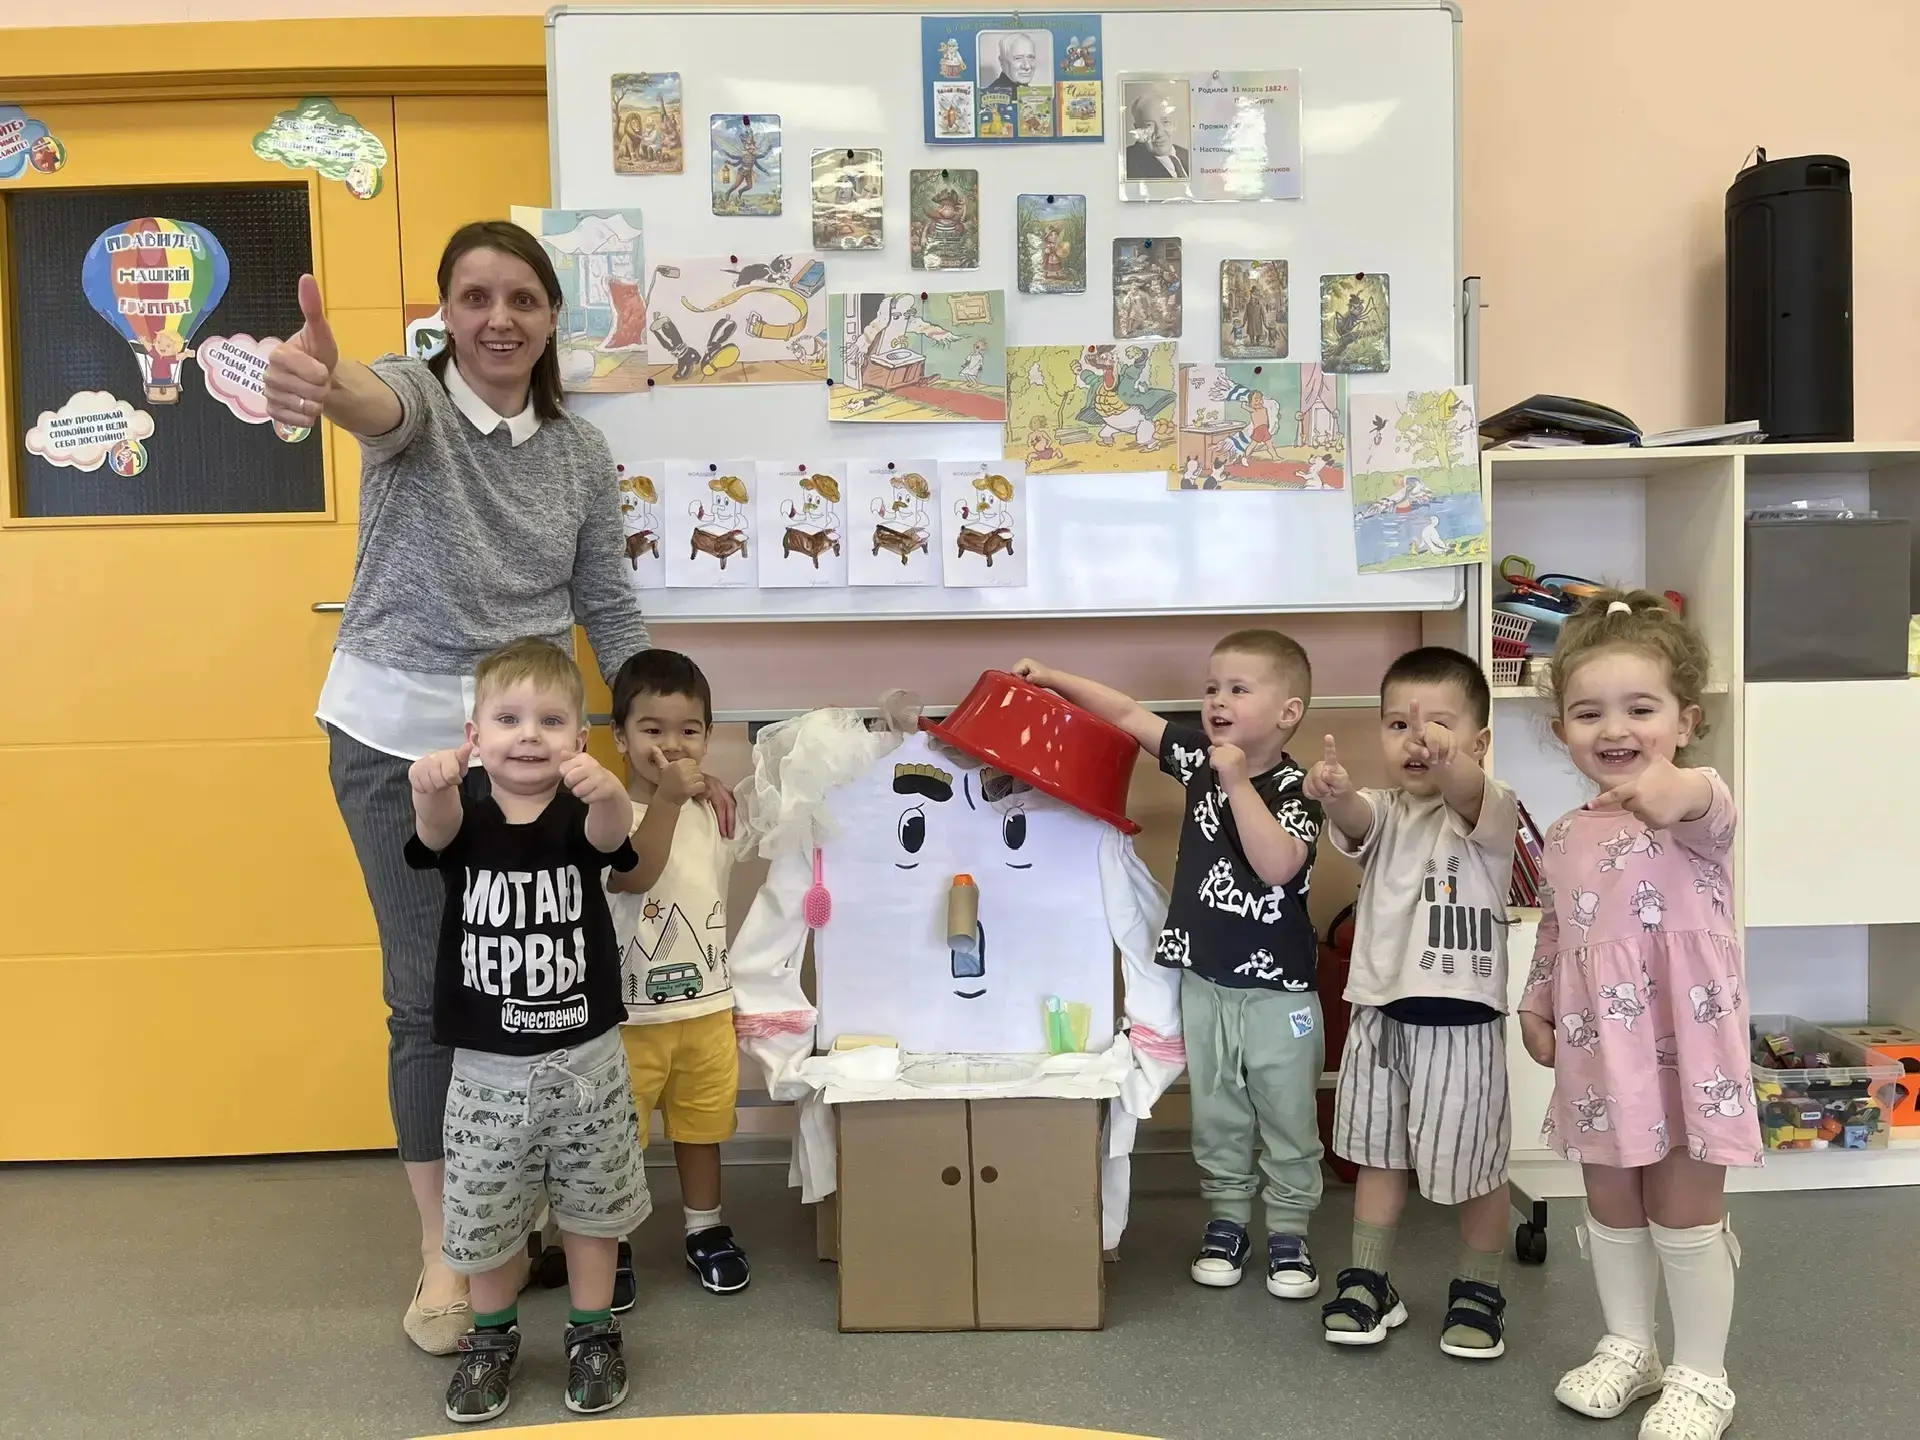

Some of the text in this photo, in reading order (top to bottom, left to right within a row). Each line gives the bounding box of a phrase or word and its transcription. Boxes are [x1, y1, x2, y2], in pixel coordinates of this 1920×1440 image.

[106, 231, 199, 252] ПРАВИЛА
[119, 266, 190, 282] НАШЕЙ
[119, 298, 192, 315] ГРУППЫ
[209, 348, 264, 382] СЛУШАЙ, БЕ
[221, 341, 269, 371] ВОСПИТАТ
[221, 368, 241, 383] СПИ
[241, 378, 250, 387] И
[50, 410, 123, 428] МАМУ ПРОВОЖАЙ
[49, 420, 128, 439] СПОКОЙНО И ВЕДИ
[55, 432, 126, 449] СЕБЯ ДОСТОЙНО!
[462, 864, 583, 929] МОТАЮ
[461, 926, 587, 997] НЕРВЫ
[505, 1002, 586, 1029] Качественно
[1296, 1013, 1312, 1026] DINO
